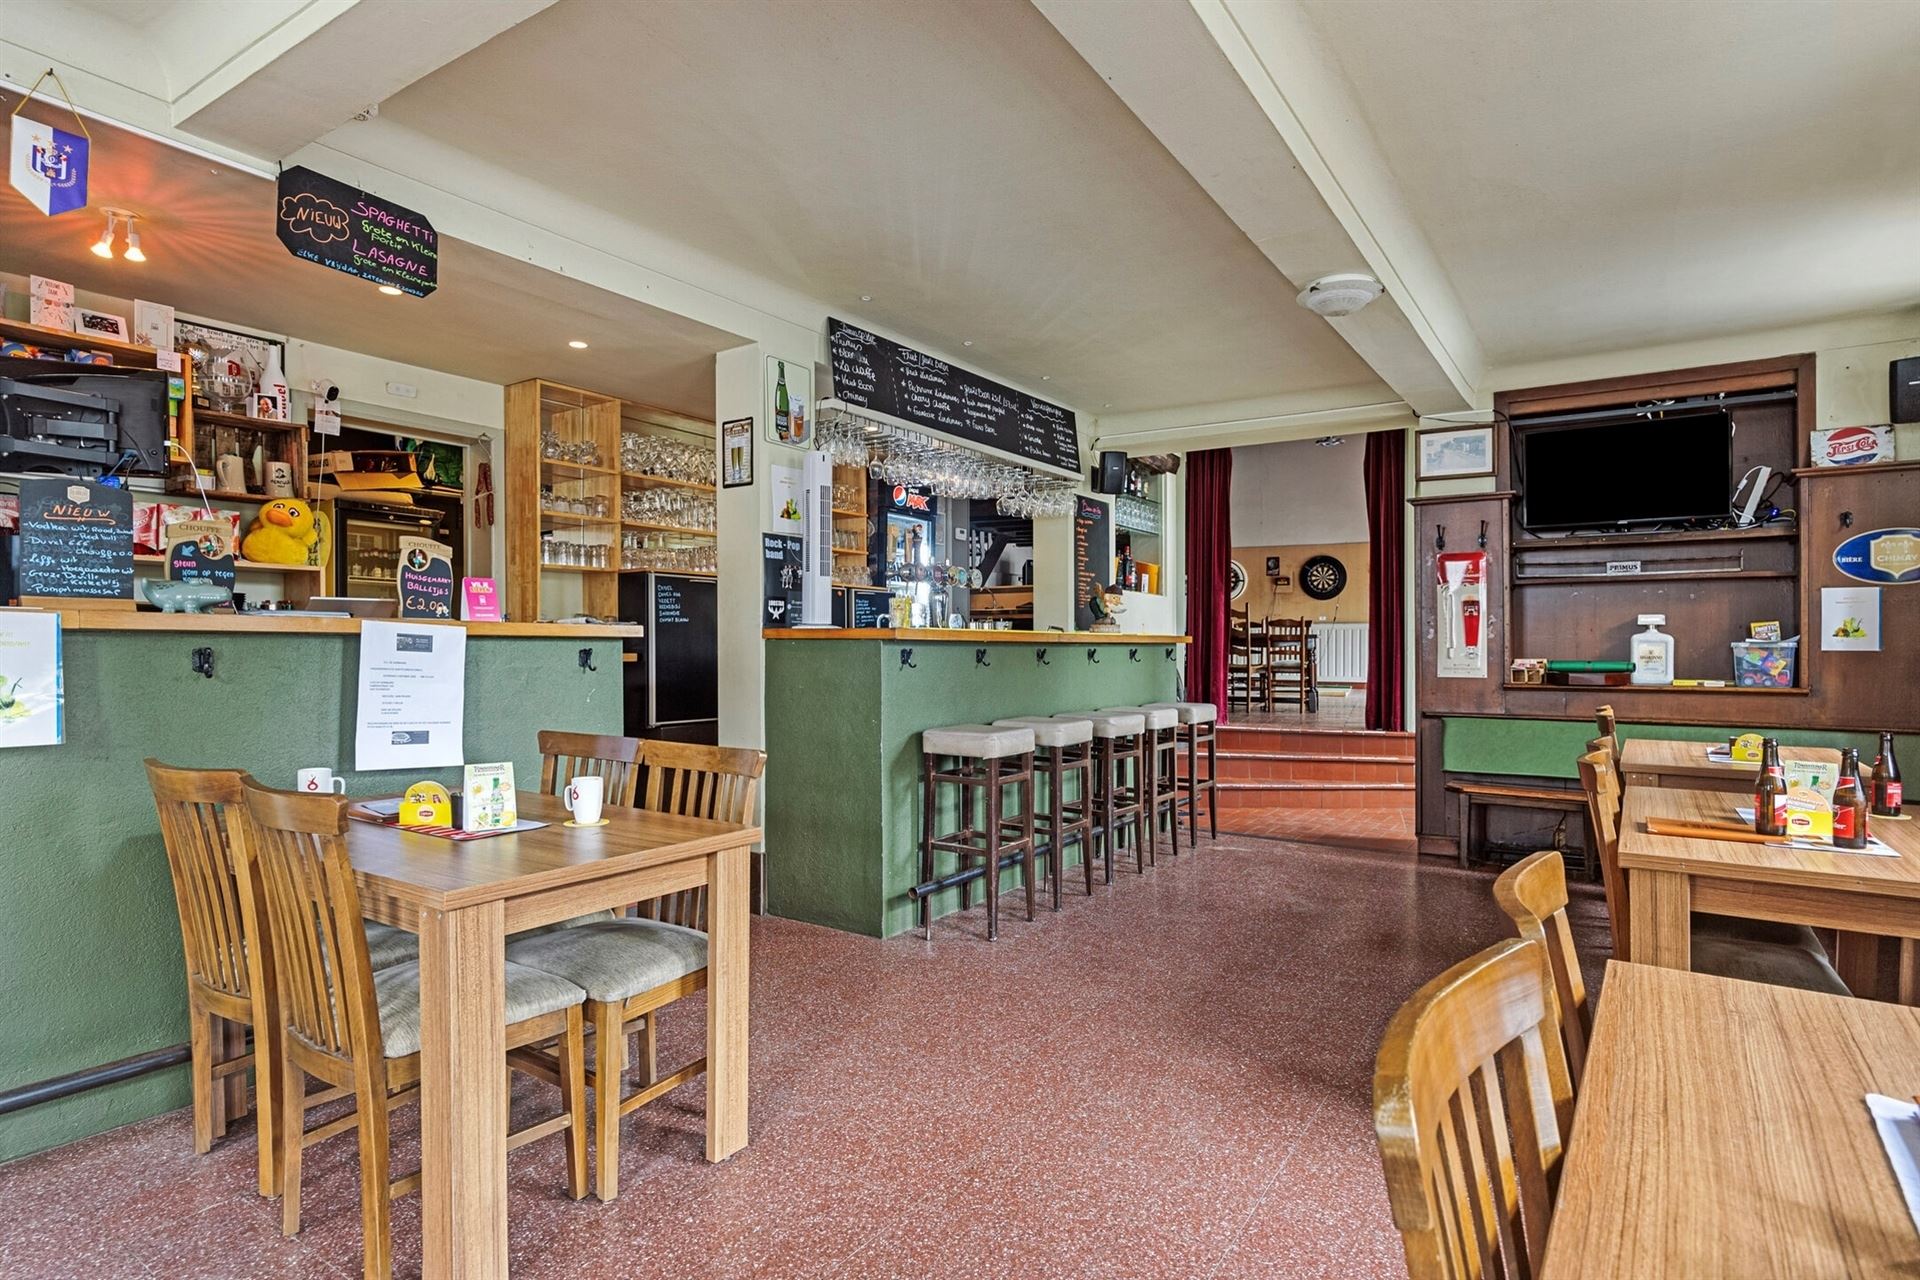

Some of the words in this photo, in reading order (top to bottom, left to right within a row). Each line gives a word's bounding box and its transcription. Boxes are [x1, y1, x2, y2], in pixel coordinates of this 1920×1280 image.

[350, 201, 434, 244] SPAGHETTI
[352, 239, 429, 277] LASAGNE
[53, 505, 110, 518] NIEUW
[906, 493, 931, 511] MAX
